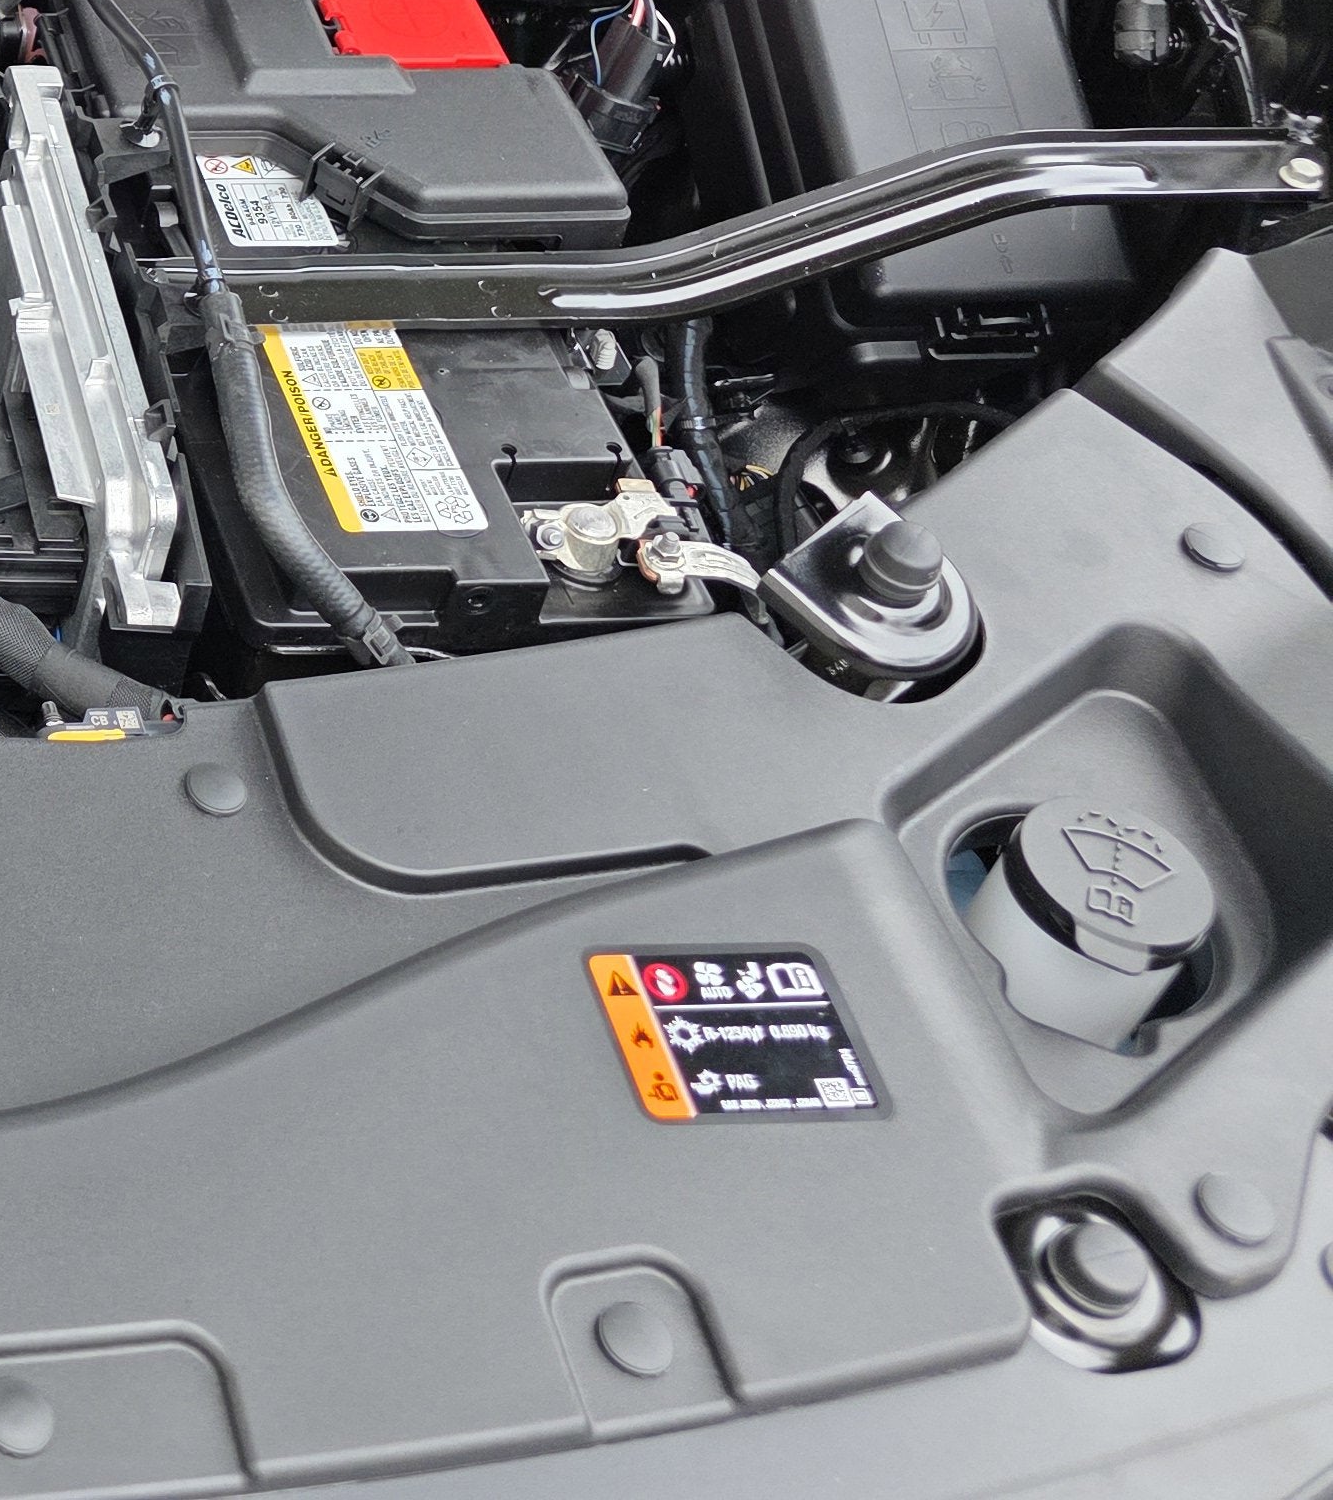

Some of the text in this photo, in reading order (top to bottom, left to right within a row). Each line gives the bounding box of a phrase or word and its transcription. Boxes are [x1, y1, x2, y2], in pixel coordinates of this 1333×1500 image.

[215, 184, 247, 239] ACDelco
[249, 200, 268, 225] 9354
[281, 369, 333, 467] DANGER/POISON
[90, 715, 109, 727] CB
[700, 986, 735, 1000] AUTO
[809, 1025, 831, 1041] kg
[725, 1073, 761, 1092] PAG
